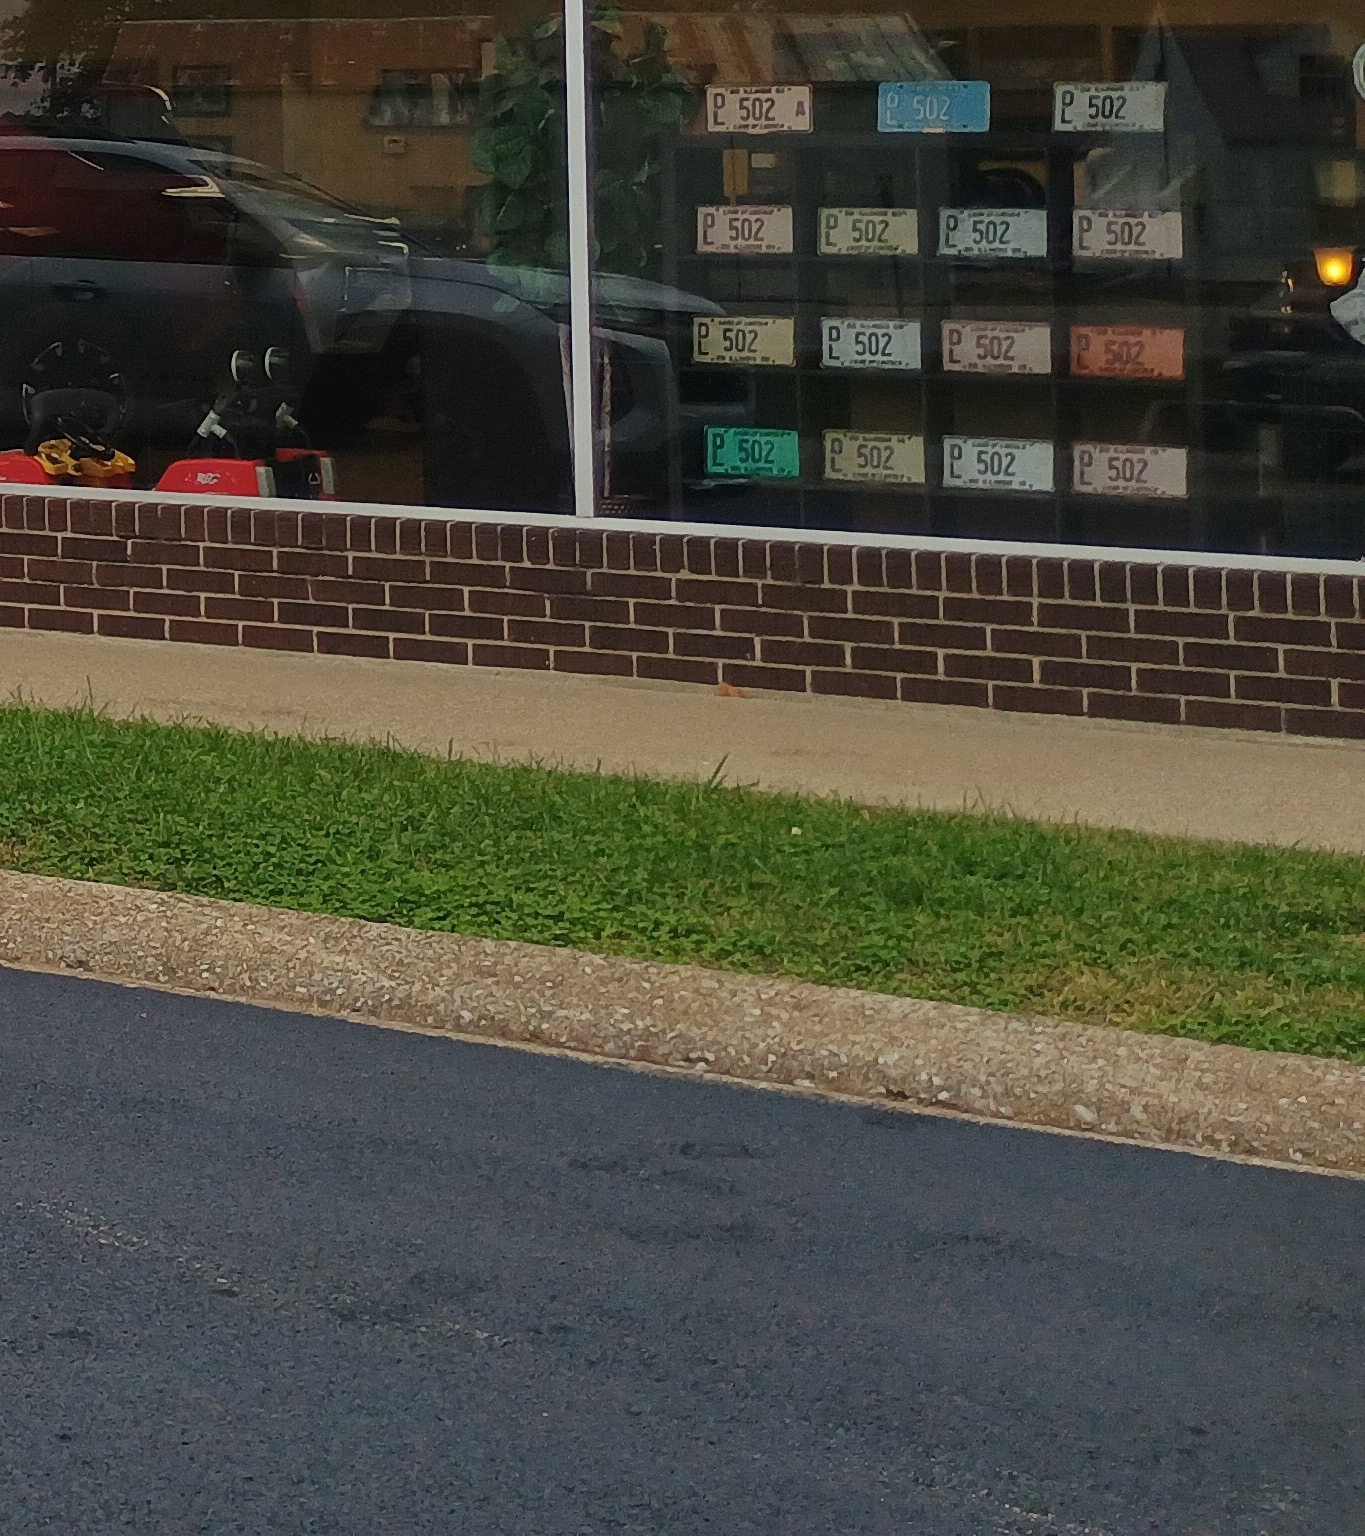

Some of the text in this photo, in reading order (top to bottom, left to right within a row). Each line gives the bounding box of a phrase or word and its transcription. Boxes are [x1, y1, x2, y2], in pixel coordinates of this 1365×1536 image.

[738, 97, 776, 121] 502
[795, 101, 806, 117] A
[913, 95, 951, 120] 502
[1088, 95, 1128, 120] 502
[728, 218, 765, 242] 502
[851, 219, 890, 244] 502
[972, 220, 1011, 245] 502
[1105, 221, 1147, 247] 502
[722, 328, 759, 353] 502
[854, 332, 893, 357] 502
[975, 334, 1016, 361] 502
[1104, 340, 1145, 365] 502
[738, 439, 775, 464] 502
[856, 444, 895, 470] 502
[976, 450, 1017, 477] 502
[1107, 456, 1149, 484] 502
